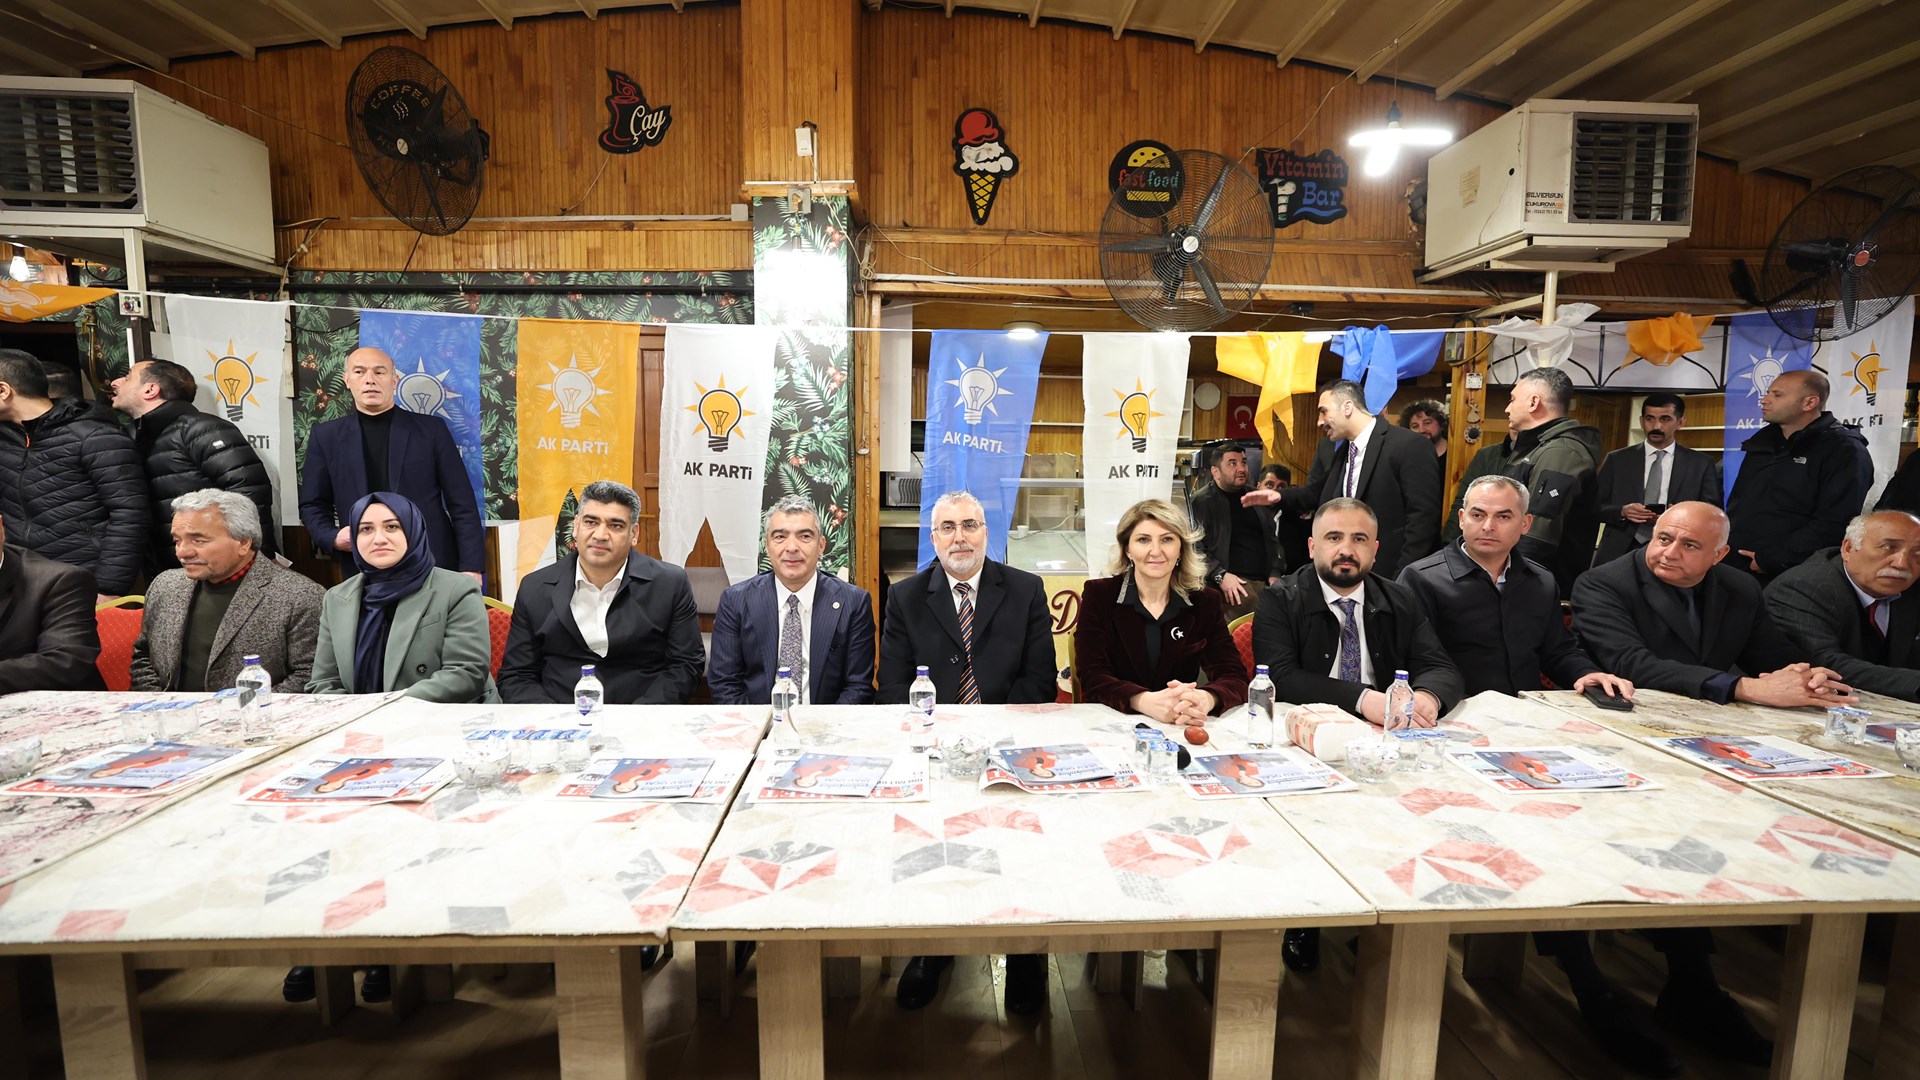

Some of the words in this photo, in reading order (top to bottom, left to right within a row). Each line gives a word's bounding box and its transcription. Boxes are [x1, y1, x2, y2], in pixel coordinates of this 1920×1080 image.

[370, 84, 431, 109] COFFEE
[630, 105, 667, 146] Çay
[1264, 152, 1345, 179] Vitamin
[1148, 169, 1181, 189] food
[1302, 181, 1341, 207] Bar
[1525, 191, 1564, 199] SILVERSUN
[1736, 417, 1755, 430] AK
[537, 436, 557, 450] AK
[942, 430, 961, 445] AK
[684, 461, 704, 476] AK
[1108, 464, 1130, 479] AK
